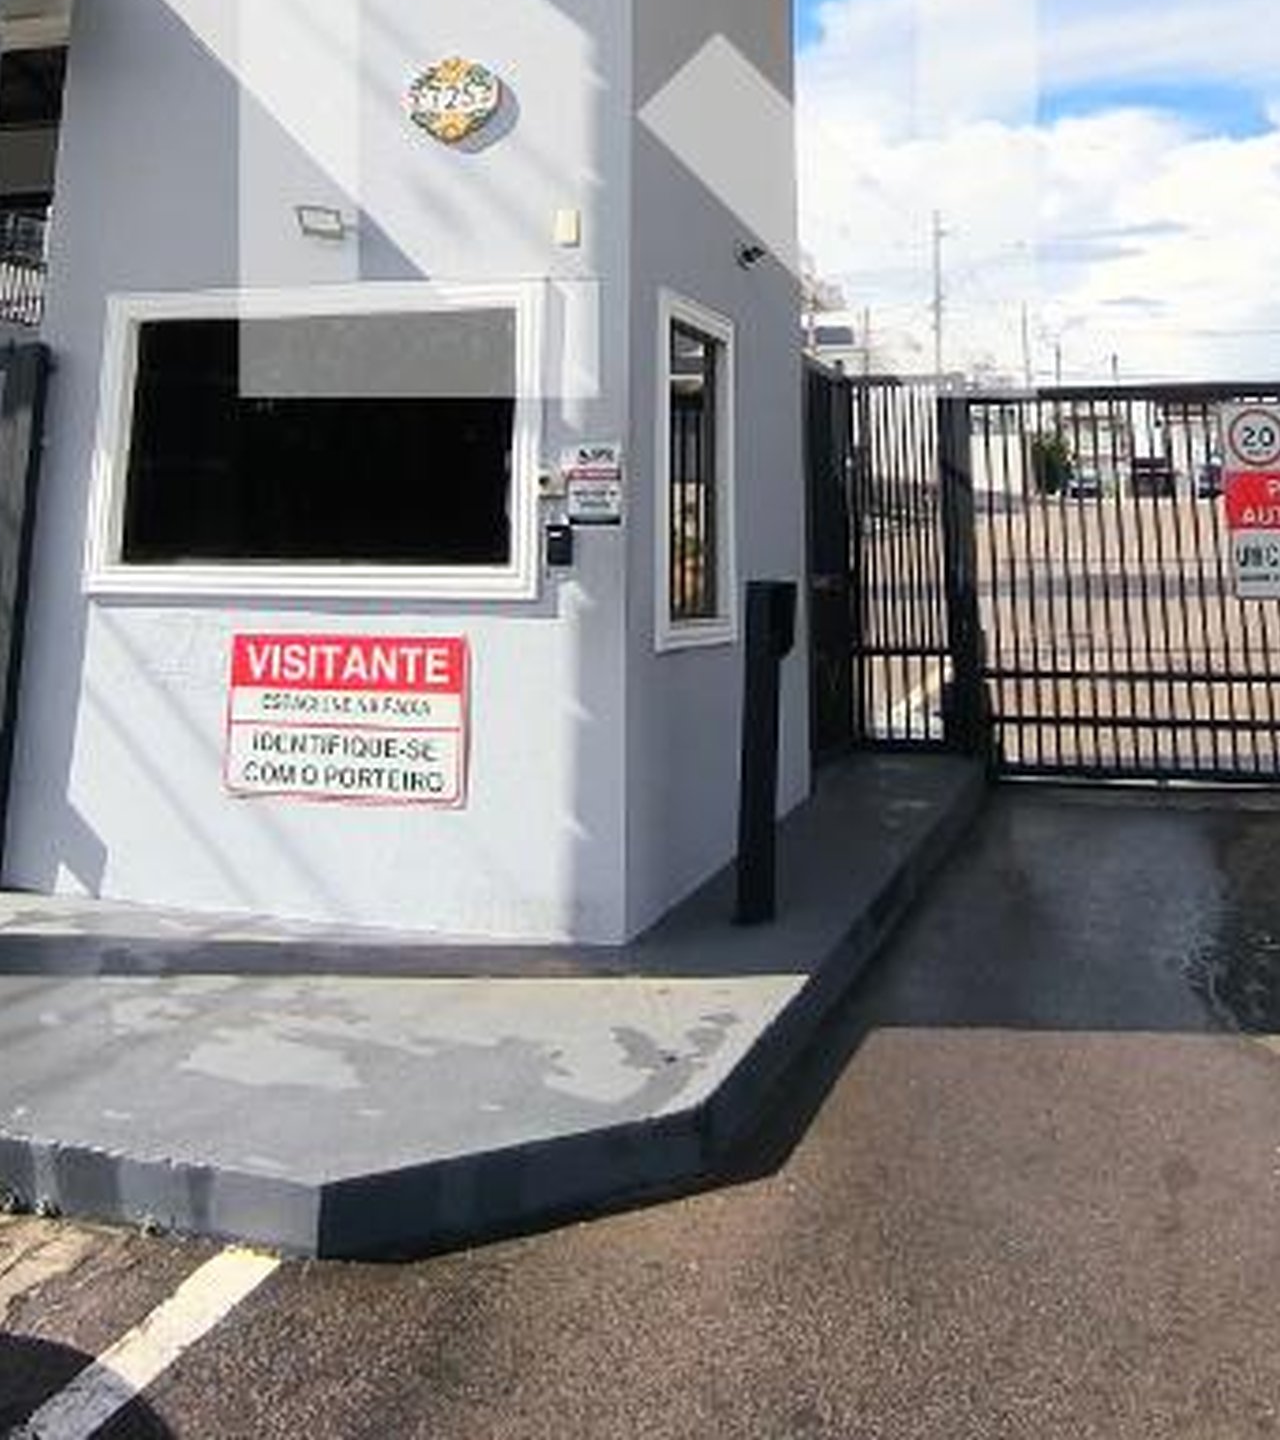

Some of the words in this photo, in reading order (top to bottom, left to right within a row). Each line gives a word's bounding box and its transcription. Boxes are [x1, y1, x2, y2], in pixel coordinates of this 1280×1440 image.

[1242, 426, 1275, 448] 20
[247, 643, 449, 683] VISITANTE
[252, 731, 440, 762] IDENTIFIQUE-SE
[324, 766, 444, 793] PORTEIRO
